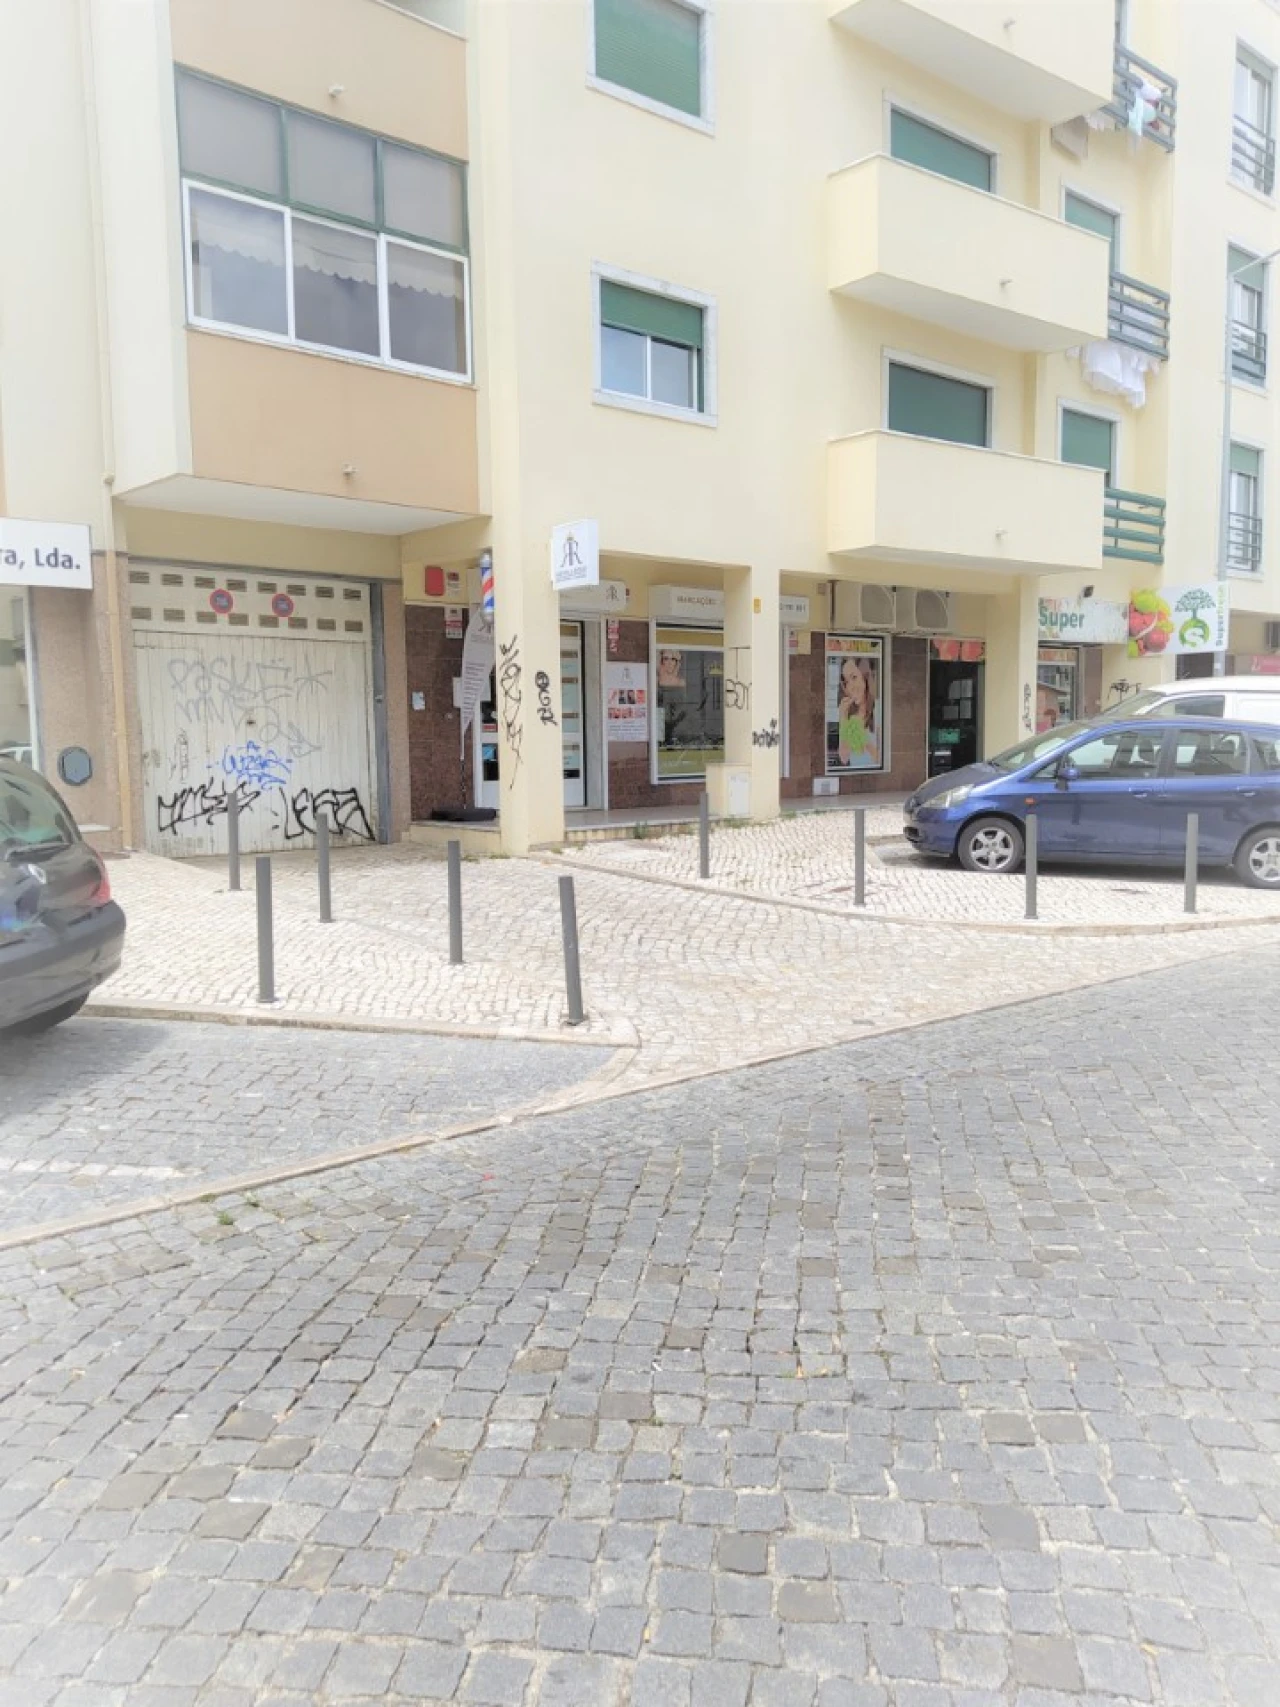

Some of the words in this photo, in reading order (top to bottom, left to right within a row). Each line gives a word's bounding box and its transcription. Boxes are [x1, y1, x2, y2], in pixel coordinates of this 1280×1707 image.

[0, 548, 25, 570] a,
[34, 547, 81, 570] Lda.
[1038, 605, 1085, 633] Super
